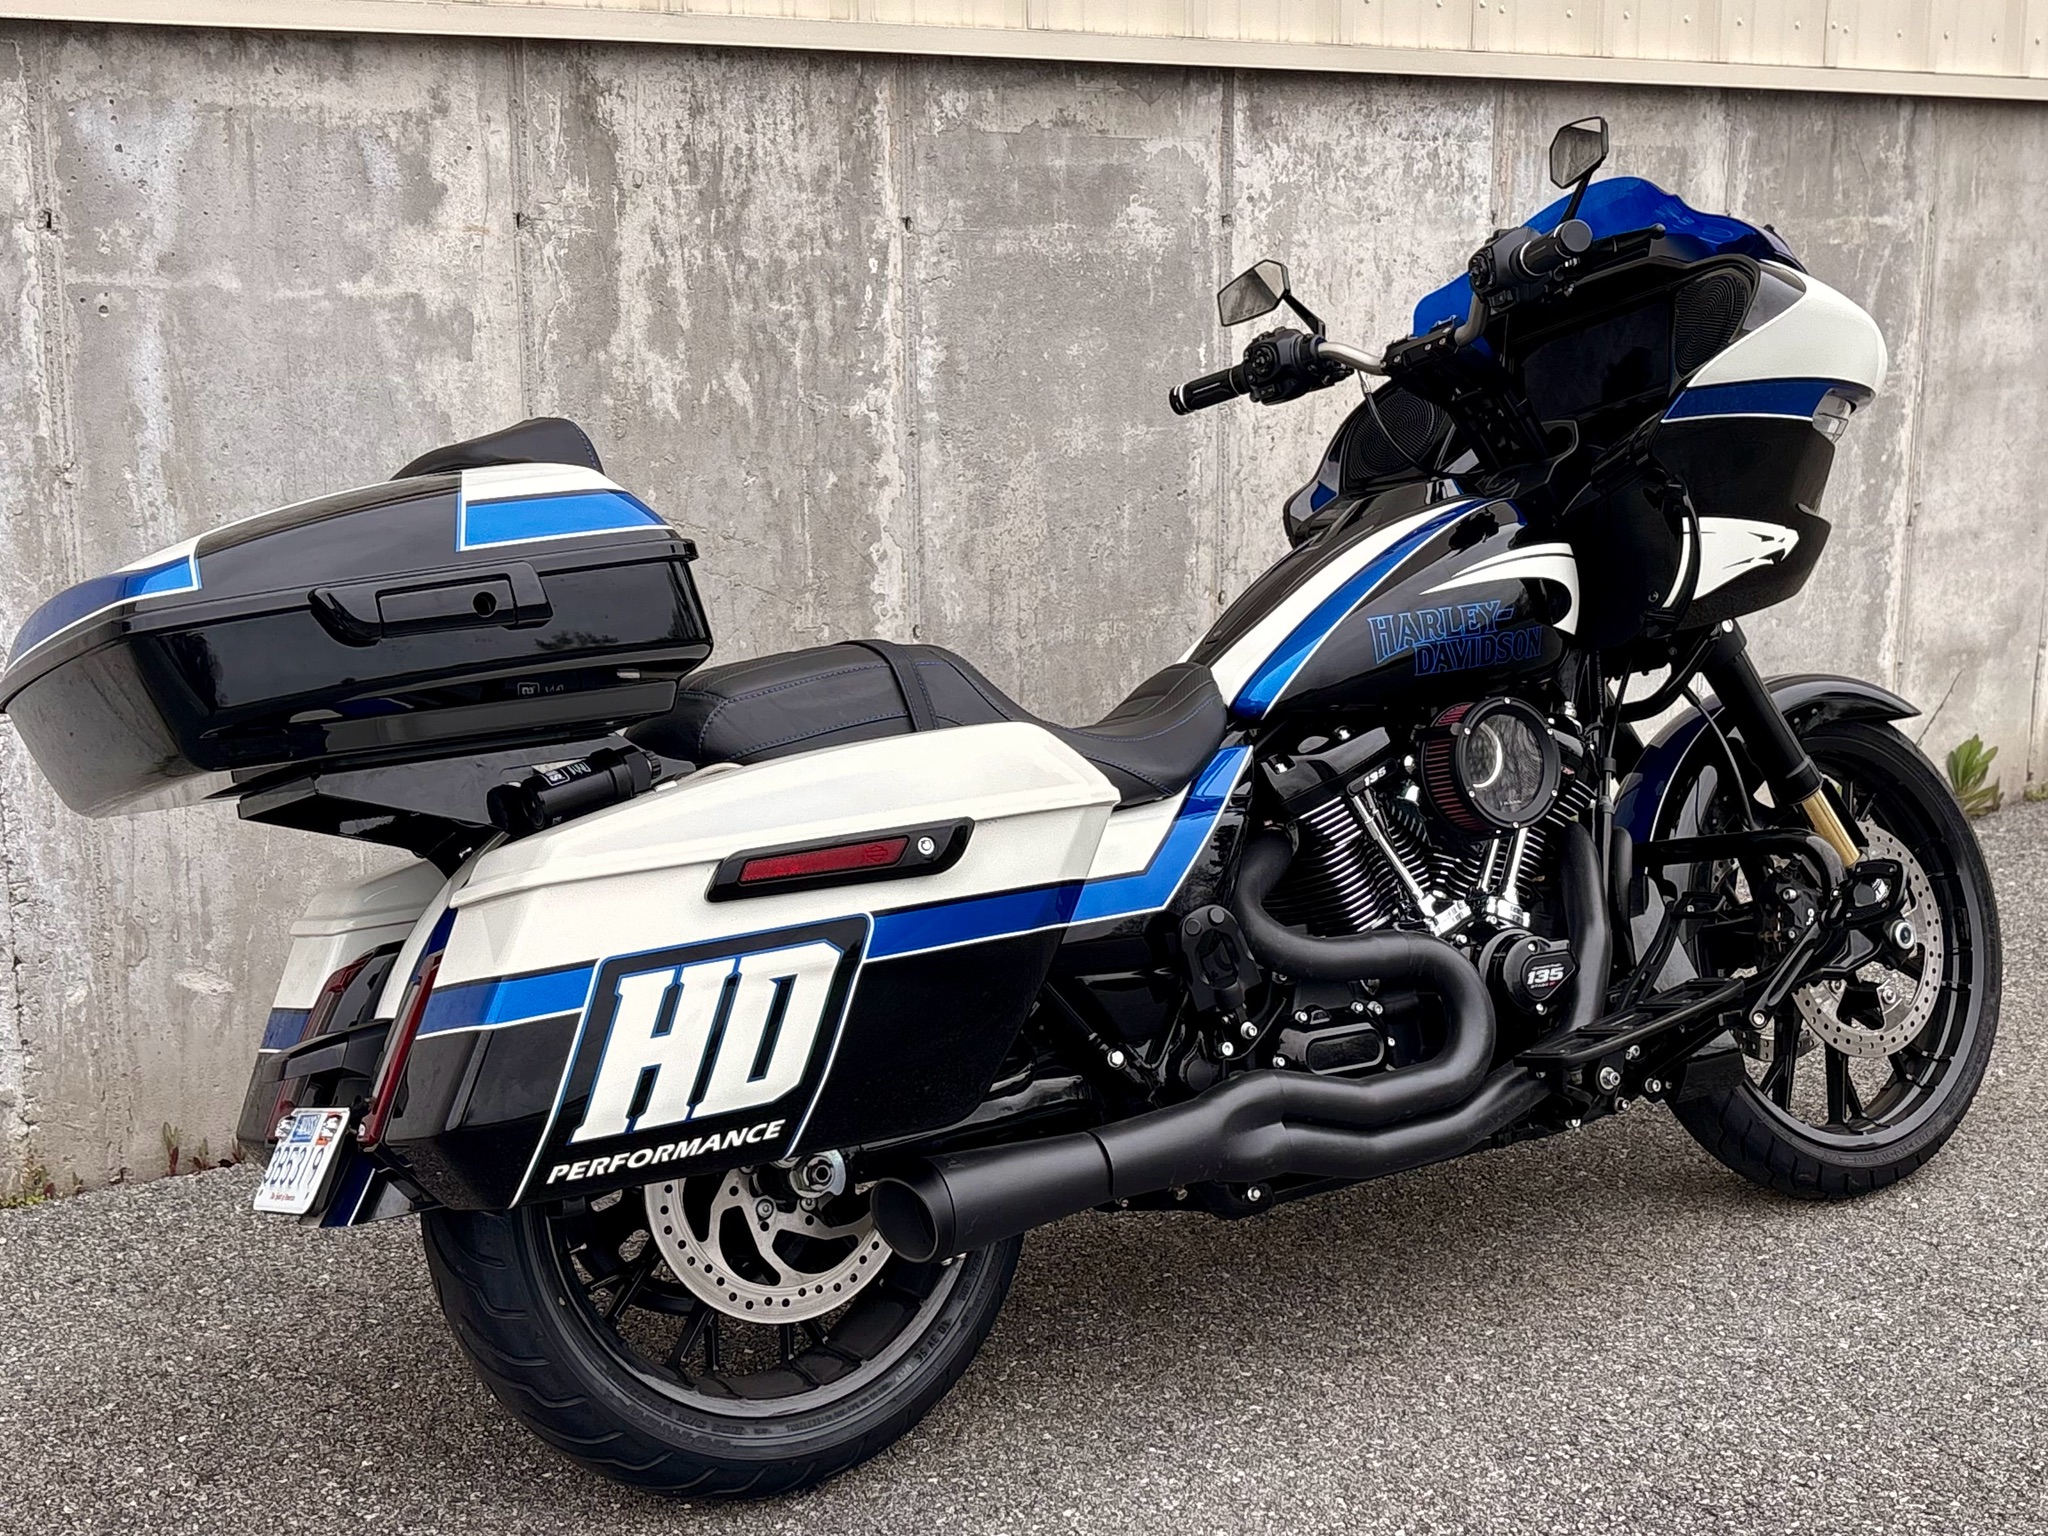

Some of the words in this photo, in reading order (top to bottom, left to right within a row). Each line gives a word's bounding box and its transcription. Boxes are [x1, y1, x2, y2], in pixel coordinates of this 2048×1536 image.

[1367, 600, 1514, 664] HARLEY-
[1414, 625, 1543, 677] DAVIDSON
[1364, 766, 1386, 786] 135
[1527, 966, 1565, 985] 135
[567, 939, 845, 1145] HD
[546, 1119, 786, 1185] PERFORMANCE
